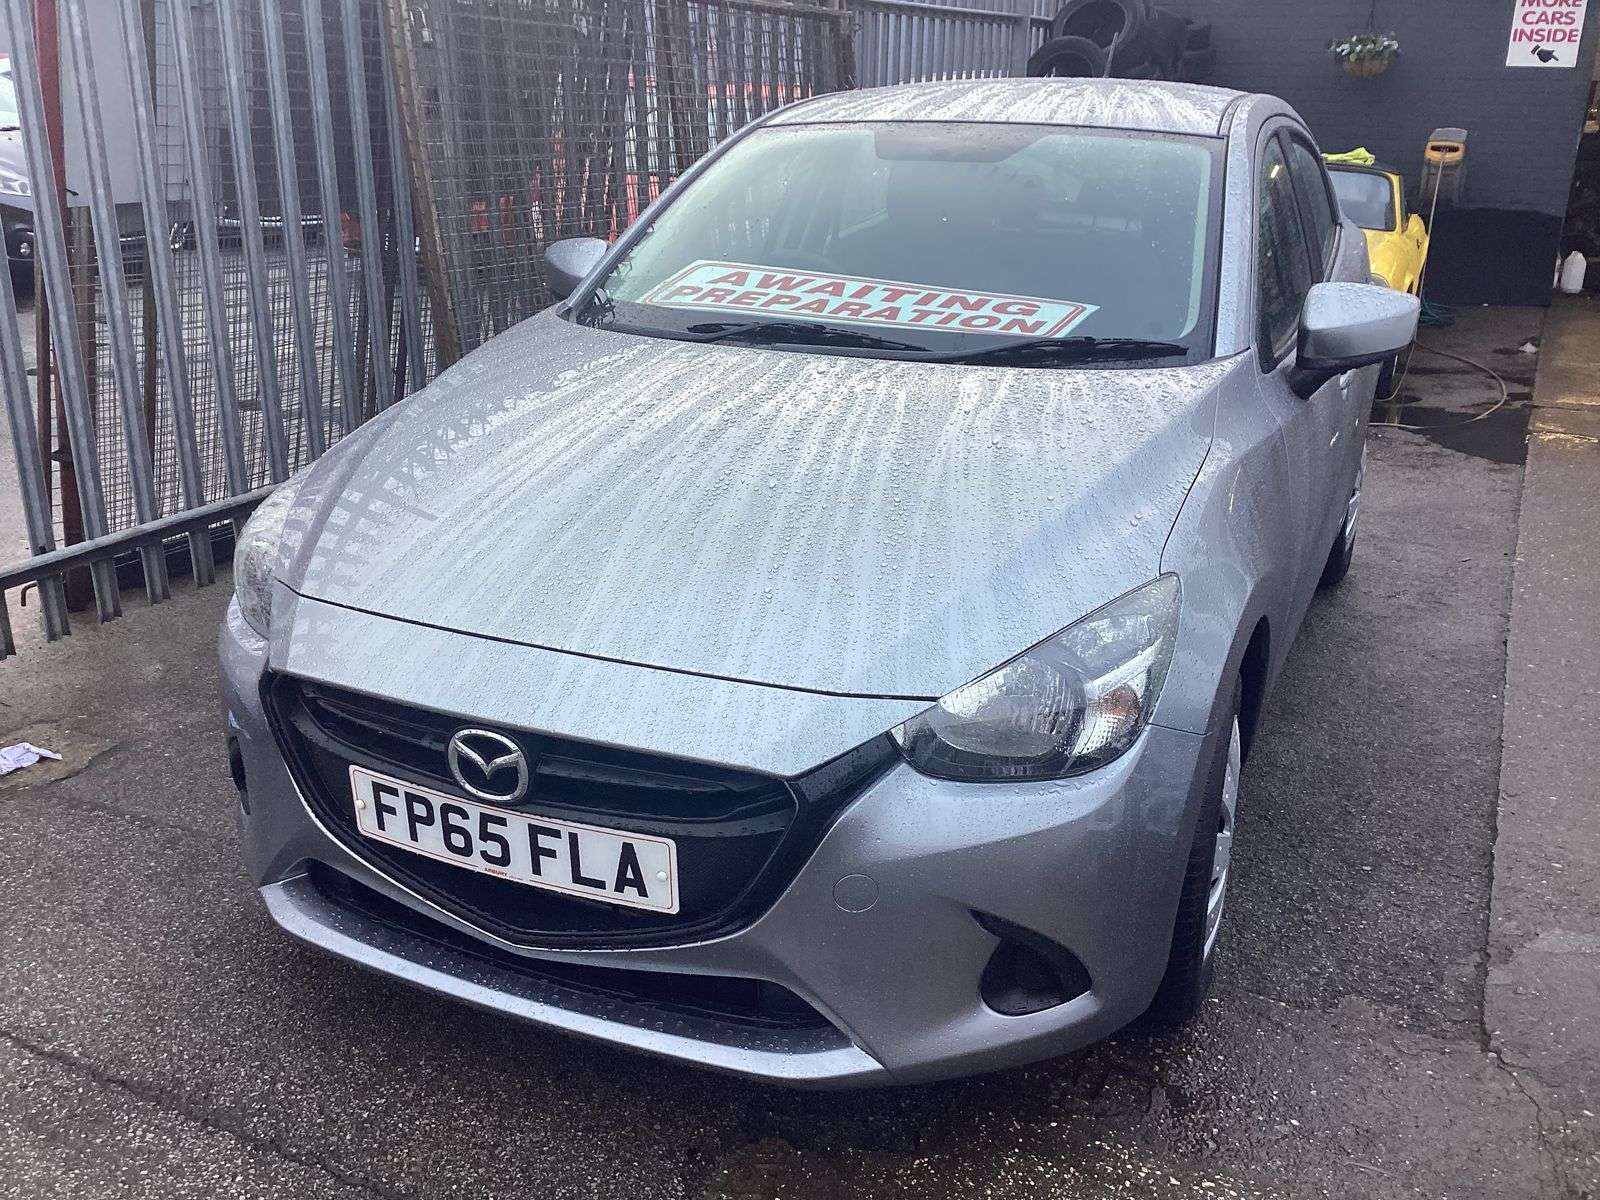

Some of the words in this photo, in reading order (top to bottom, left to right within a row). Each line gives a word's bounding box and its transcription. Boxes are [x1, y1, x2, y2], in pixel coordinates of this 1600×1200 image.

[1512, 28, 1579, 42] INSIDE
[1522, 11, 1576, 25] CARS
[661, 285, 1048, 333] PREPARATION
[705, 271, 1041, 316] AWAITING
[371, 780, 511, 868] FP65
[527, 822, 649, 898] FLA
